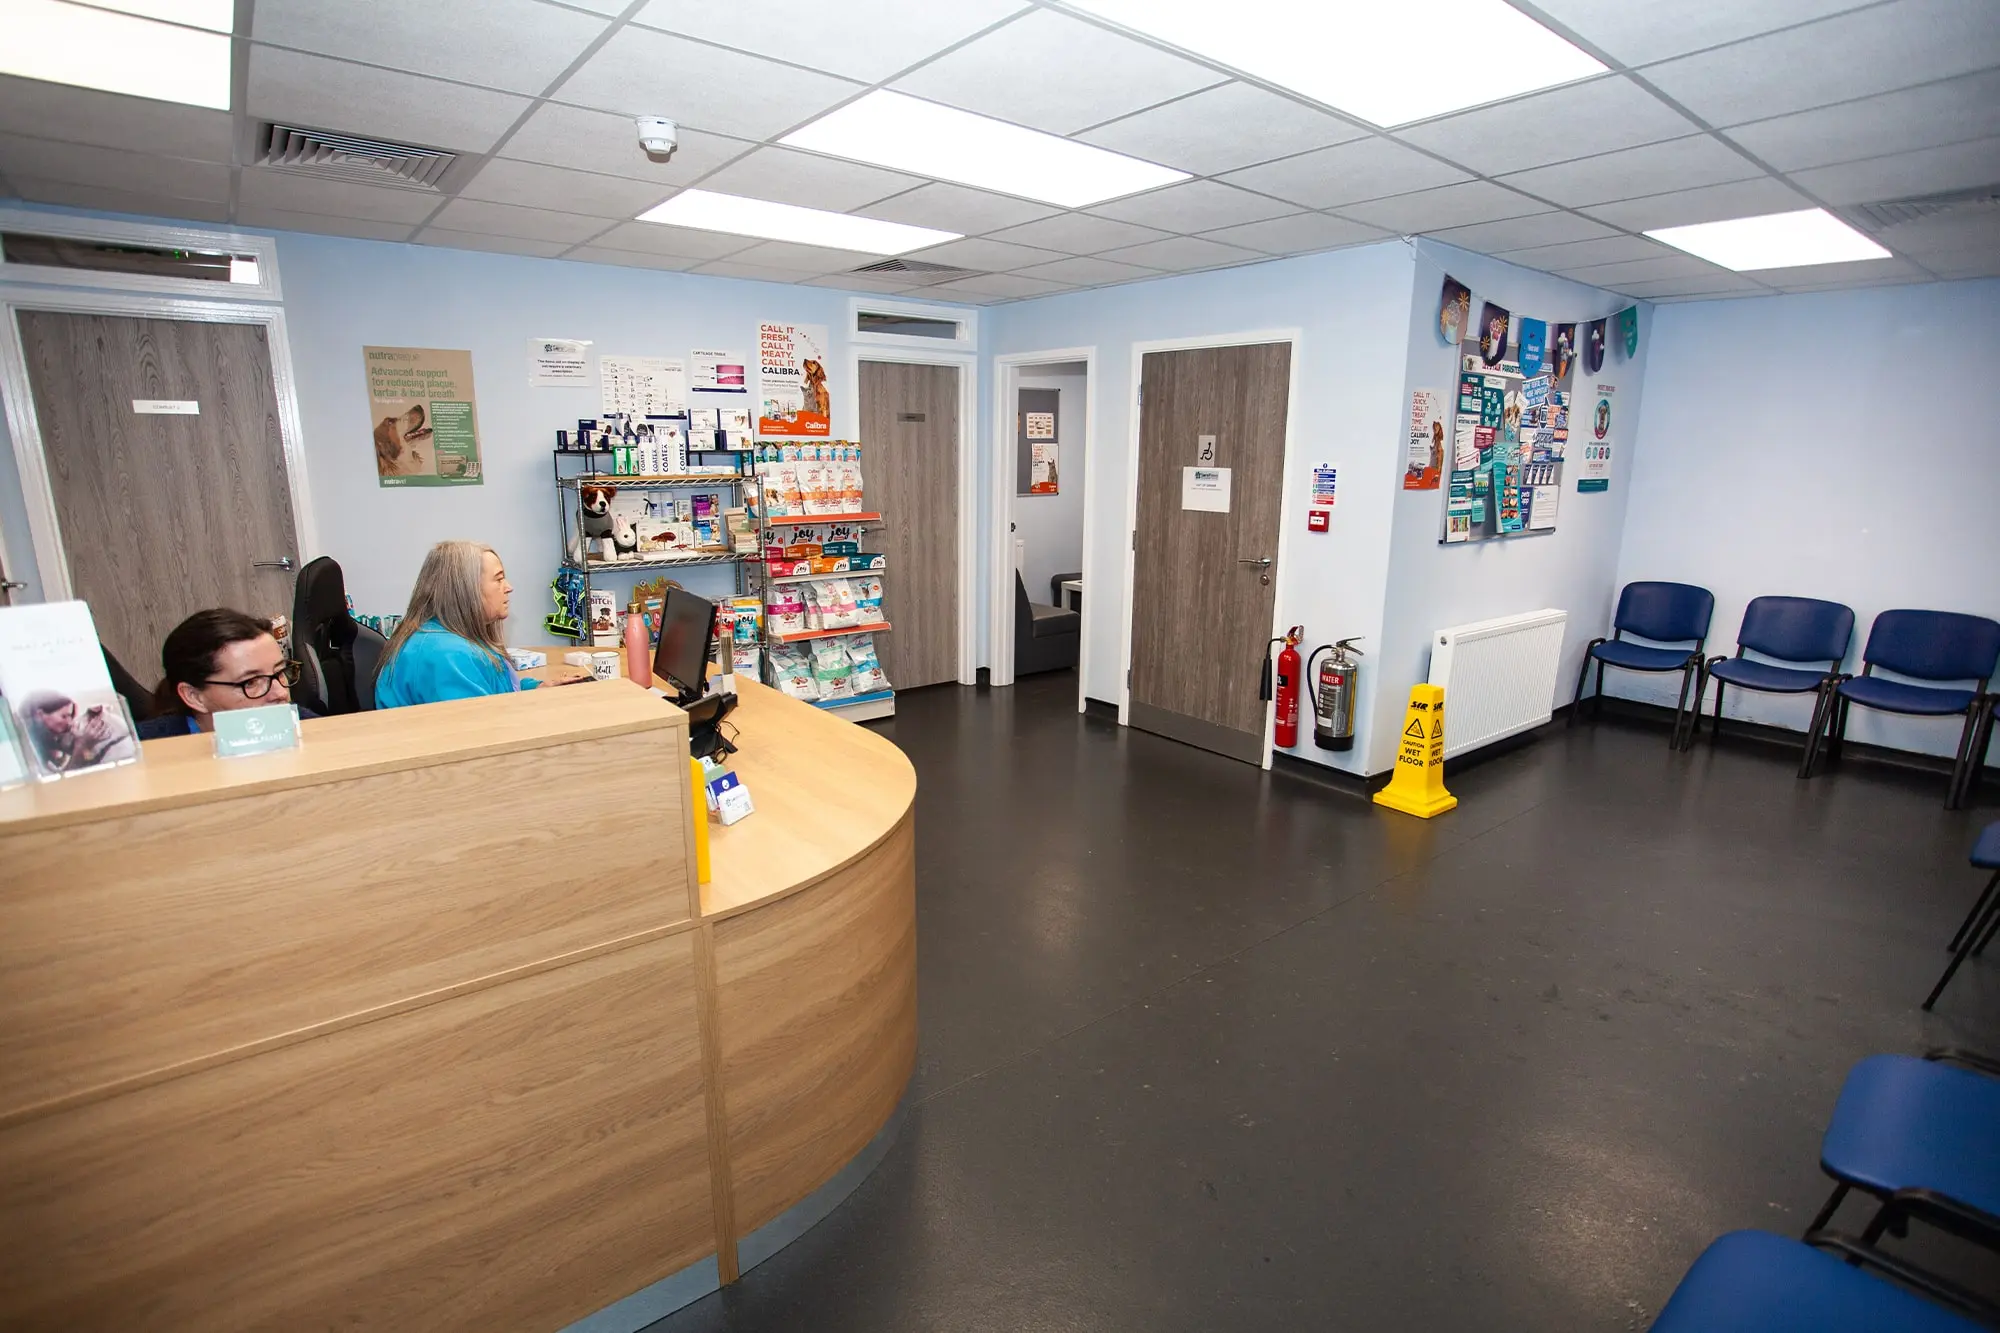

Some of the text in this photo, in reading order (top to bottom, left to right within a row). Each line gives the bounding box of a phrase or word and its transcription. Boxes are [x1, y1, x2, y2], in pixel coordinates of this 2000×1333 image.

[761, 324, 794, 334] CALL IT
[761, 332, 792, 342] FRESH.
[761, 341, 795, 351] CALL IT
[761, 349, 794, 359] MEATY.
[762, 358, 795, 367] CALL IT
[371, 366, 448, 379] Advanced support
[372, 377, 385, 387] for
[387, 378, 425, 389] reducing
[373, 388, 398, 398] tartar
[410, 389, 426, 398] bad
[428, 390, 456, 399] breath
[790, 526, 815, 545] joy
[827, 524, 850, 542] joy
[796, 565, 807, 574] joy
[836, 561, 847, 570] joy
[1321, 674, 1340, 684] WATER
[1402, 740, 1425, 749] CAUTION
[1404, 747, 1421, 757] WET
[1431, 748, 1441, 758] WET
[1398, 754, 1424, 768] FLOOR
[1428, 756, 1444, 768] FLOOR
